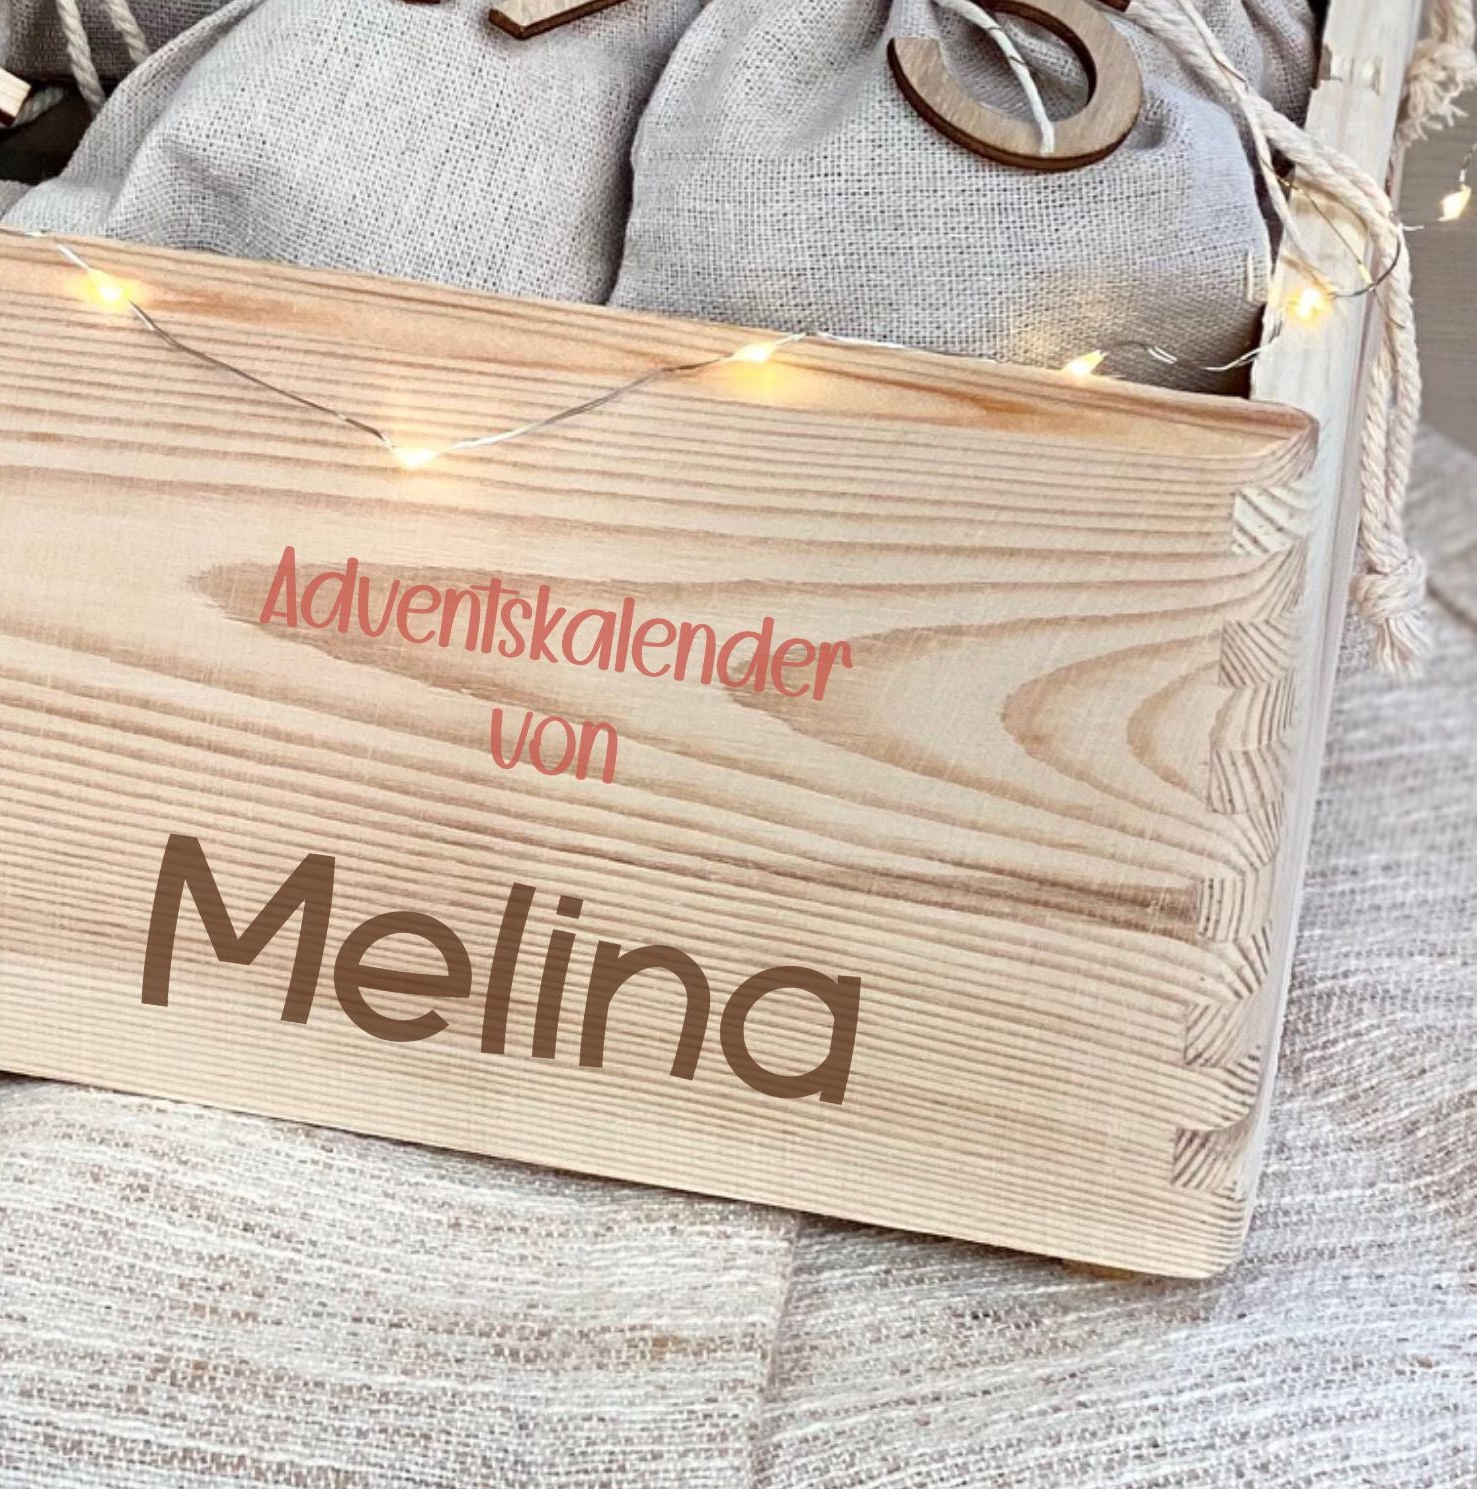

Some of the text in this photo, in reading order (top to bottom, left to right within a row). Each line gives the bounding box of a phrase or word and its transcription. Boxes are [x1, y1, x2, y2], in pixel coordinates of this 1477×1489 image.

[259, 545, 854, 701] Adventskalender
[489, 707, 619, 784] von
[140, 832, 862, 1105] Melina
